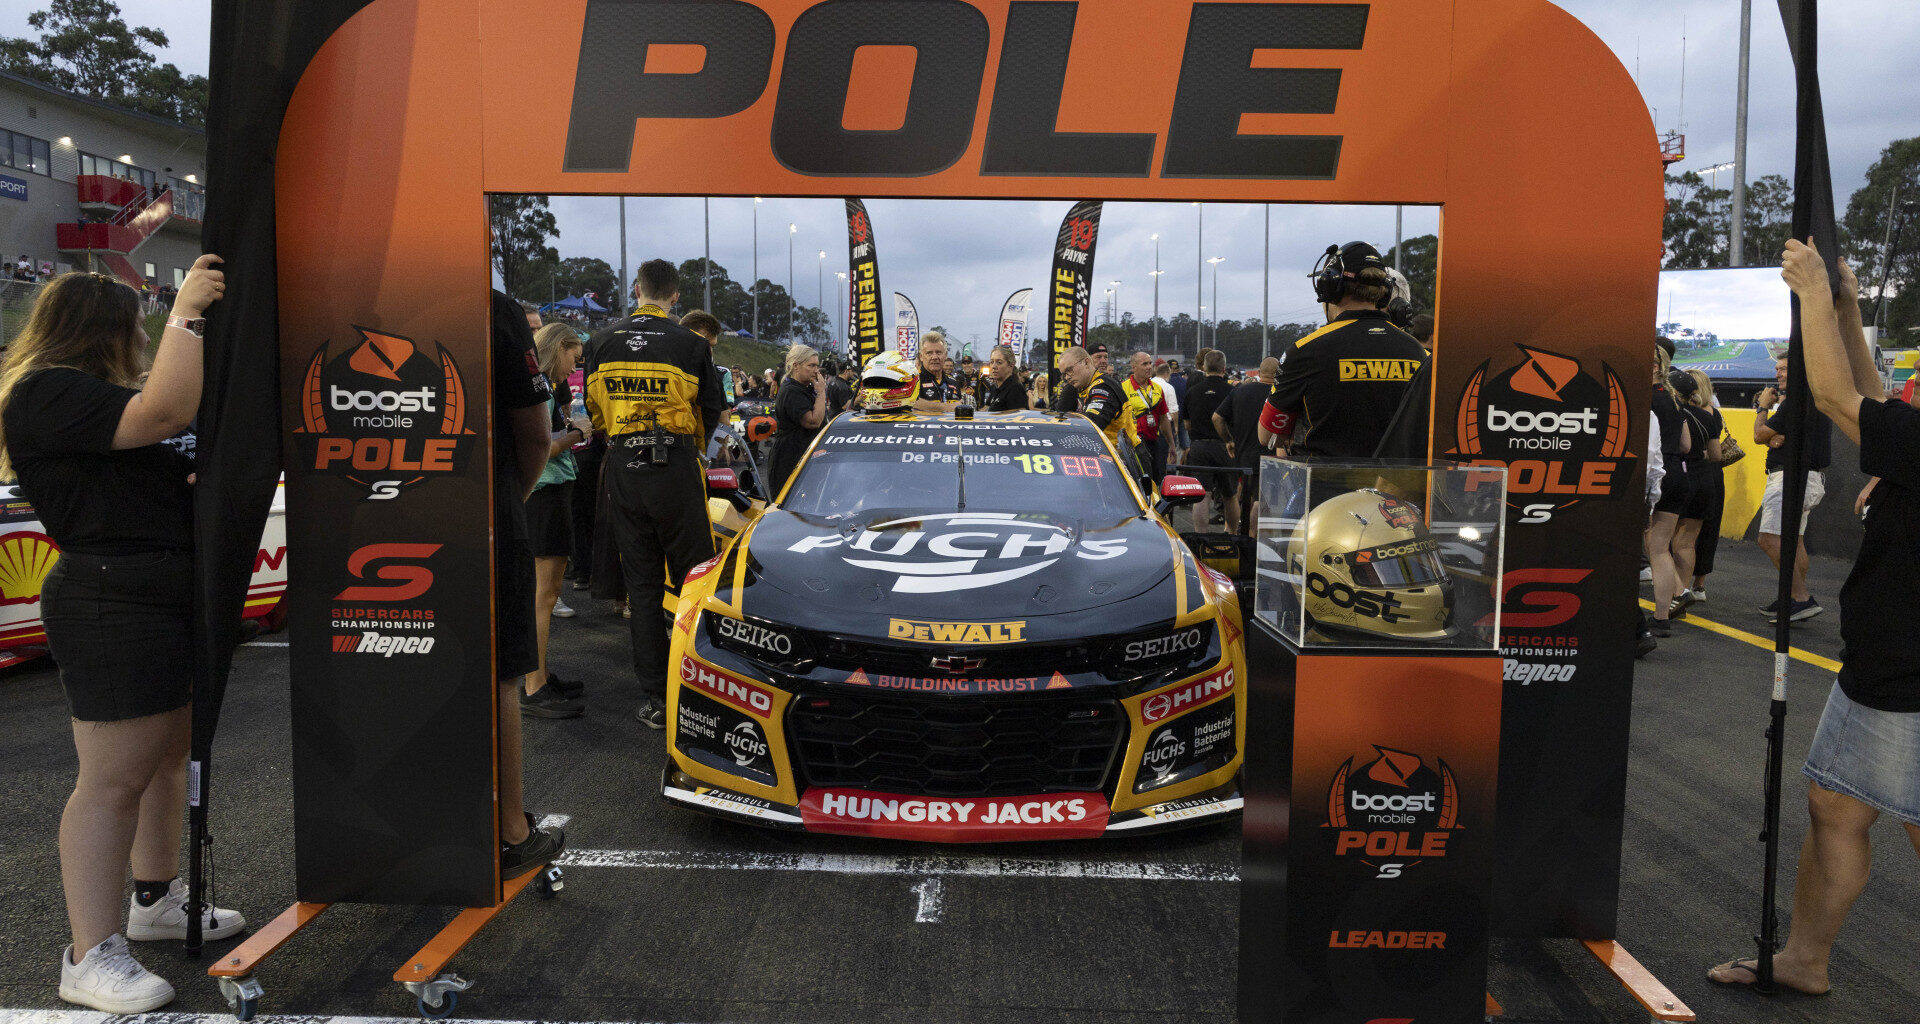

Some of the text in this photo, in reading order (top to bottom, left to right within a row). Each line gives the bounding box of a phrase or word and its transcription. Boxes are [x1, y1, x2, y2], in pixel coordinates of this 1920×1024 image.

[562, 0, 1371, 180] POLE
[851, 211, 867, 245] 19
[1069, 217, 1093, 250] 19
[1062, 248, 1089, 265] PAYNE
[1001, 320, 1014, 346] MOL
[1074, 303, 1084, 346] CING
[331, 385, 436, 412] boost
[353, 415, 413, 428] mobile
[1272, 413, 1290, 429] 3
[1487, 404, 1598, 435] boost
[824, 434, 1053, 447] Industrial Batteries
[1509, 436, 1572, 450] mobile
[315, 437, 457, 471] POLE
[901, 452, 1010, 466] De Pasquale
[1014, 454, 1055, 475] 18
[1464, 459, 1617, 495] POLE
[786, 531, 1129, 561] FUCHS
[331, 608, 435, 620] SUPERCARS
[331, 620, 435, 630] CHAMPIONSHIP
[356, 631, 436, 658] Repco
[719, 616, 792, 655] SEIKO
[1124, 628, 1201, 662] SEIKO
[1499, 635, 1579, 647] PERCARS
[1498, 647, 1578, 657] MPIONSHIP
[877, 675, 1038, 691] BUILDING TRUST
[1502, 658, 1577, 686] Repco
[699, 669, 771, 712] HINO
[1173, 671, 1235, 708] HINO
[679, 703, 718, 728] Industrial
[679, 714, 716, 739] Batteries
[1194, 716, 1233, 737] Industrial
[723, 731, 767, 756] FUCHS
[1194, 728, 1231, 748] Batteries
[1143, 741, 1186, 766] FUCHS
[701, 796, 766, 816] PRESTIGE
[709, 789, 771, 809] PENINSULA
[822, 793, 1087, 824] HUNGRY JACK'S
[1164, 802, 1227, 820] PRESTIGE
[1351, 790, 1436, 812] boost
[1368, 813, 1416, 824] mobile
[1335, 831, 1450, 857] POLE
[1329, 930, 1447, 949] LEADER
